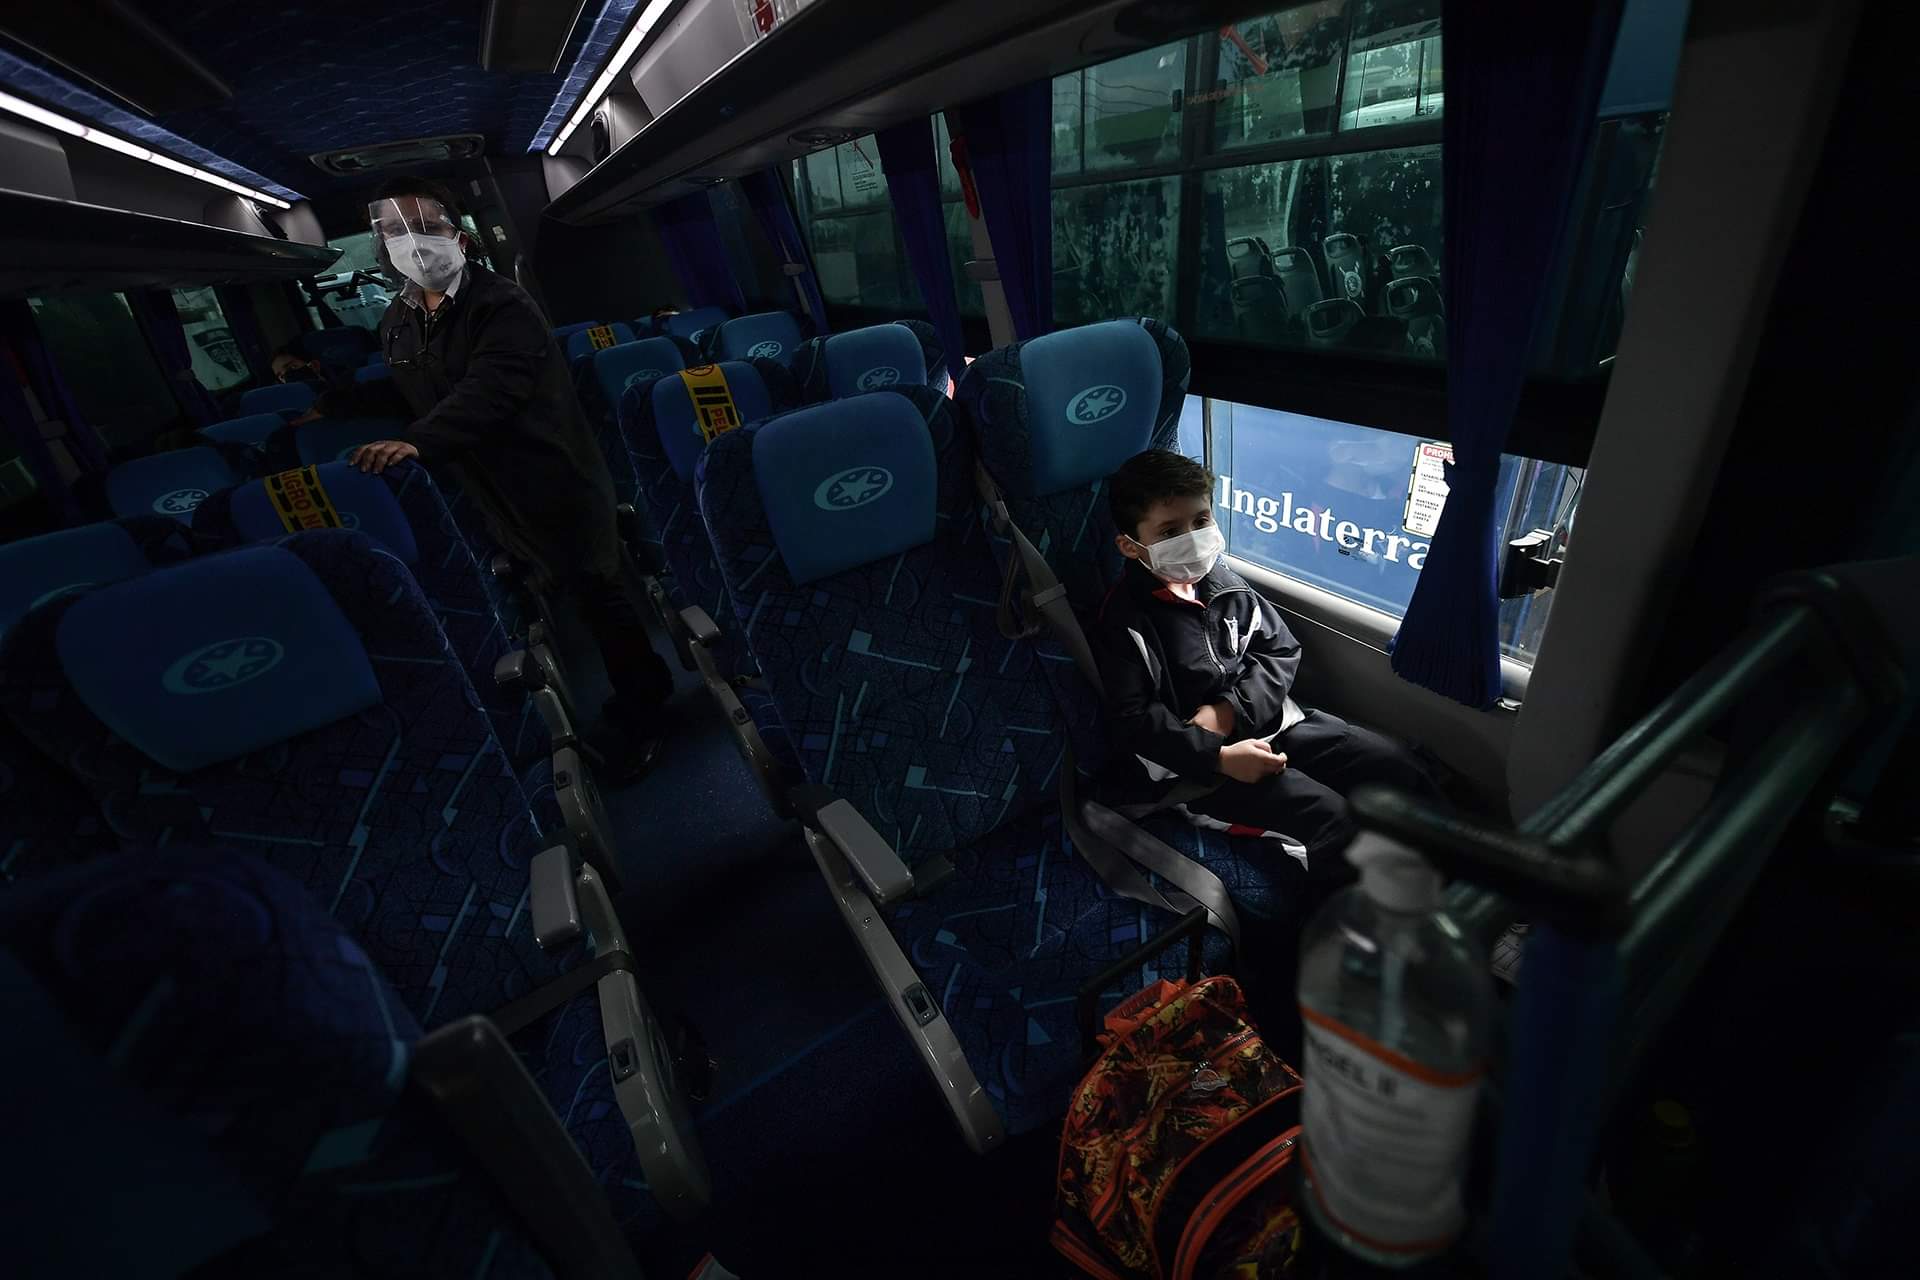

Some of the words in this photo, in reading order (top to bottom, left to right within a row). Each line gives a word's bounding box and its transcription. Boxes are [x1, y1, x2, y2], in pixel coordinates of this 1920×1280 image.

[710, 408, 729, 434] PEL
[1426, 448, 1455, 460] PROHI
[1218, 475, 1431, 570] Inglaterra
